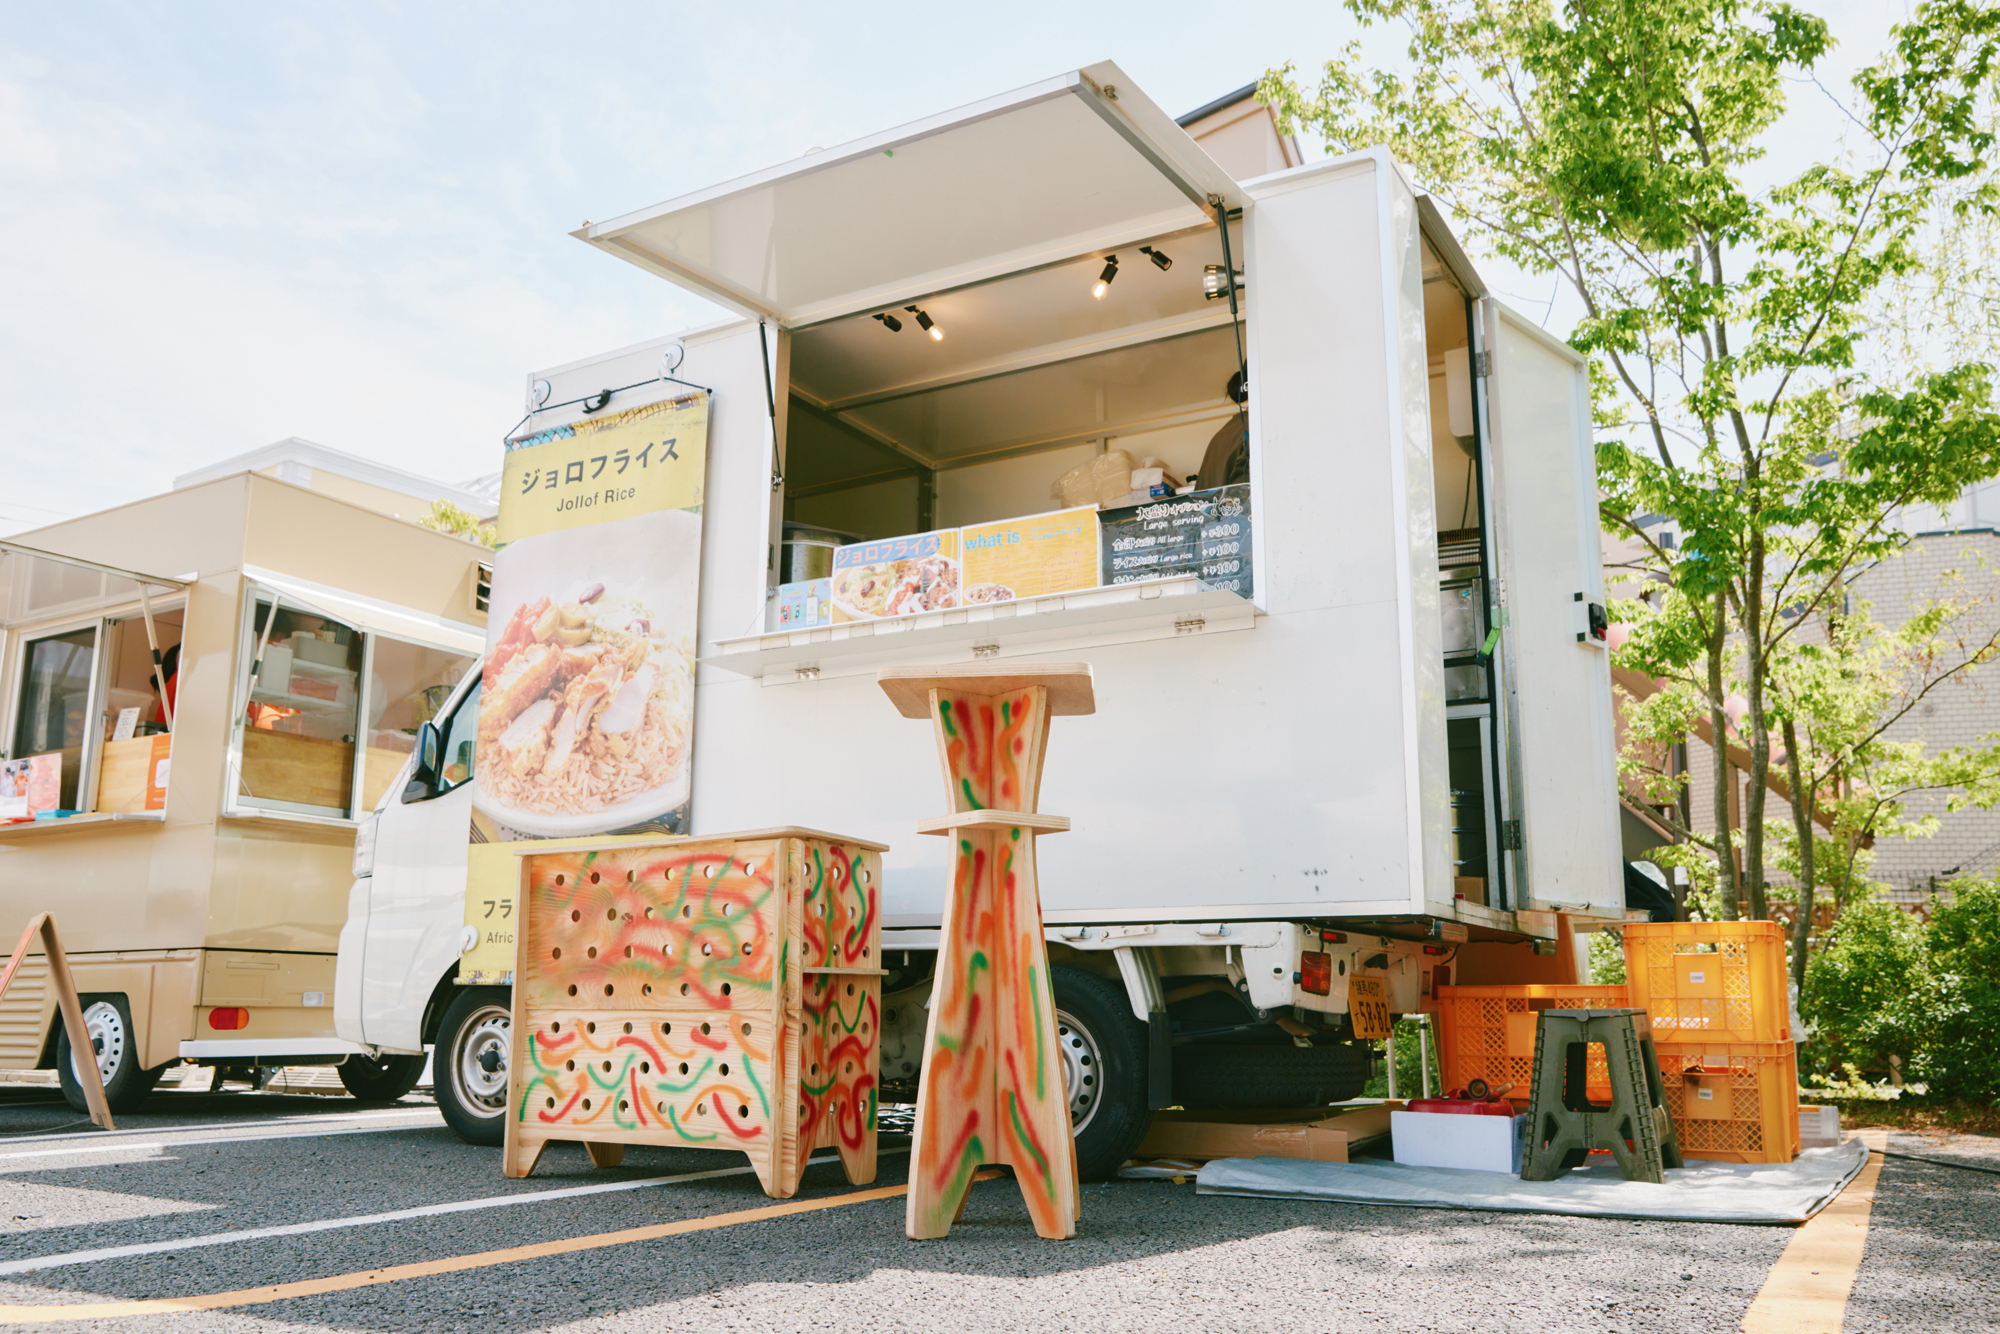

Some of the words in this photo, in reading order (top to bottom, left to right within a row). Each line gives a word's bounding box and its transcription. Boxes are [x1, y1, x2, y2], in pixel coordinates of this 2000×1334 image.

[521, 438, 679, 495] ジョロフライス
[556, 492, 600, 512] Jollof
[604, 487, 636, 503] Rice
[1143, 521, 1169, 531] Large
[1172, 515, 1205, 527] serving
[964, 532, 1003, 551] what
[1007, 529, 1020, 545] is
[1168, 534, 1185, 543] large
[836, 536, 938, 567] ジョロフライス
[1160, 554, 1179, 562] Large
[1180, 552, 1194, 560] rice
[1213, 579, 1240, 592] 100
[483, 899, 512, 919] フラ
[486, 931, 514, 944] Afric
